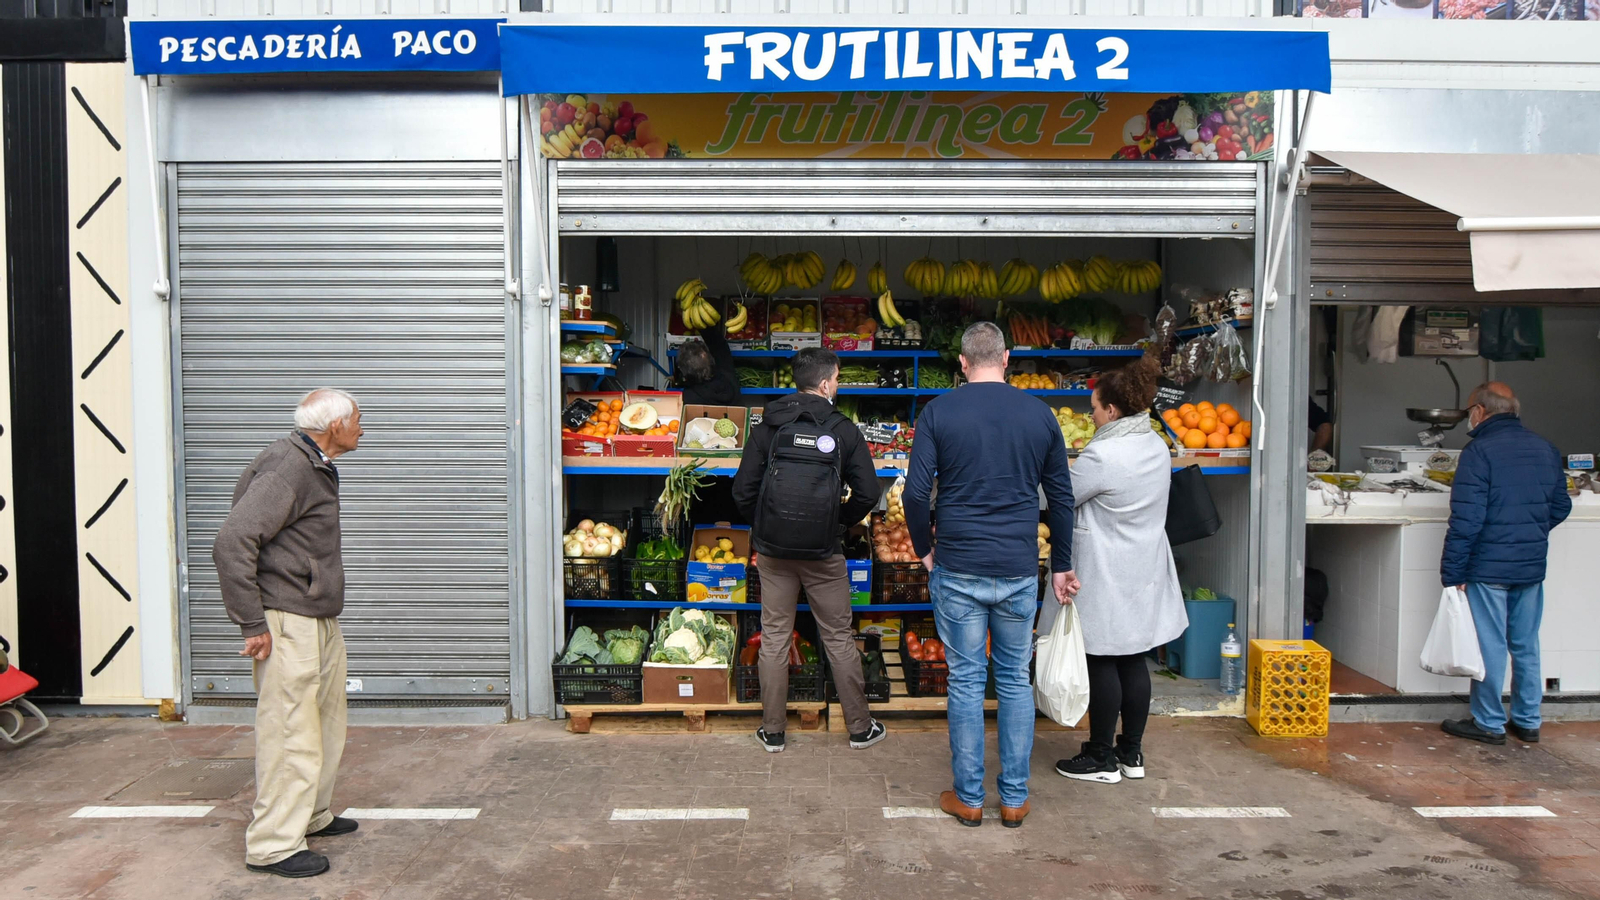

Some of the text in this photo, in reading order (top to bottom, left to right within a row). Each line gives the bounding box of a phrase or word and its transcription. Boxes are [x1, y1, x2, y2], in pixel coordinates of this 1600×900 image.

[159, 25, 477, 63] PESCADERÍA PACO
[704, 30, 1129, 81] FRUTILINEA 2
[705, 91, 1100, 158] frutilinea 2
